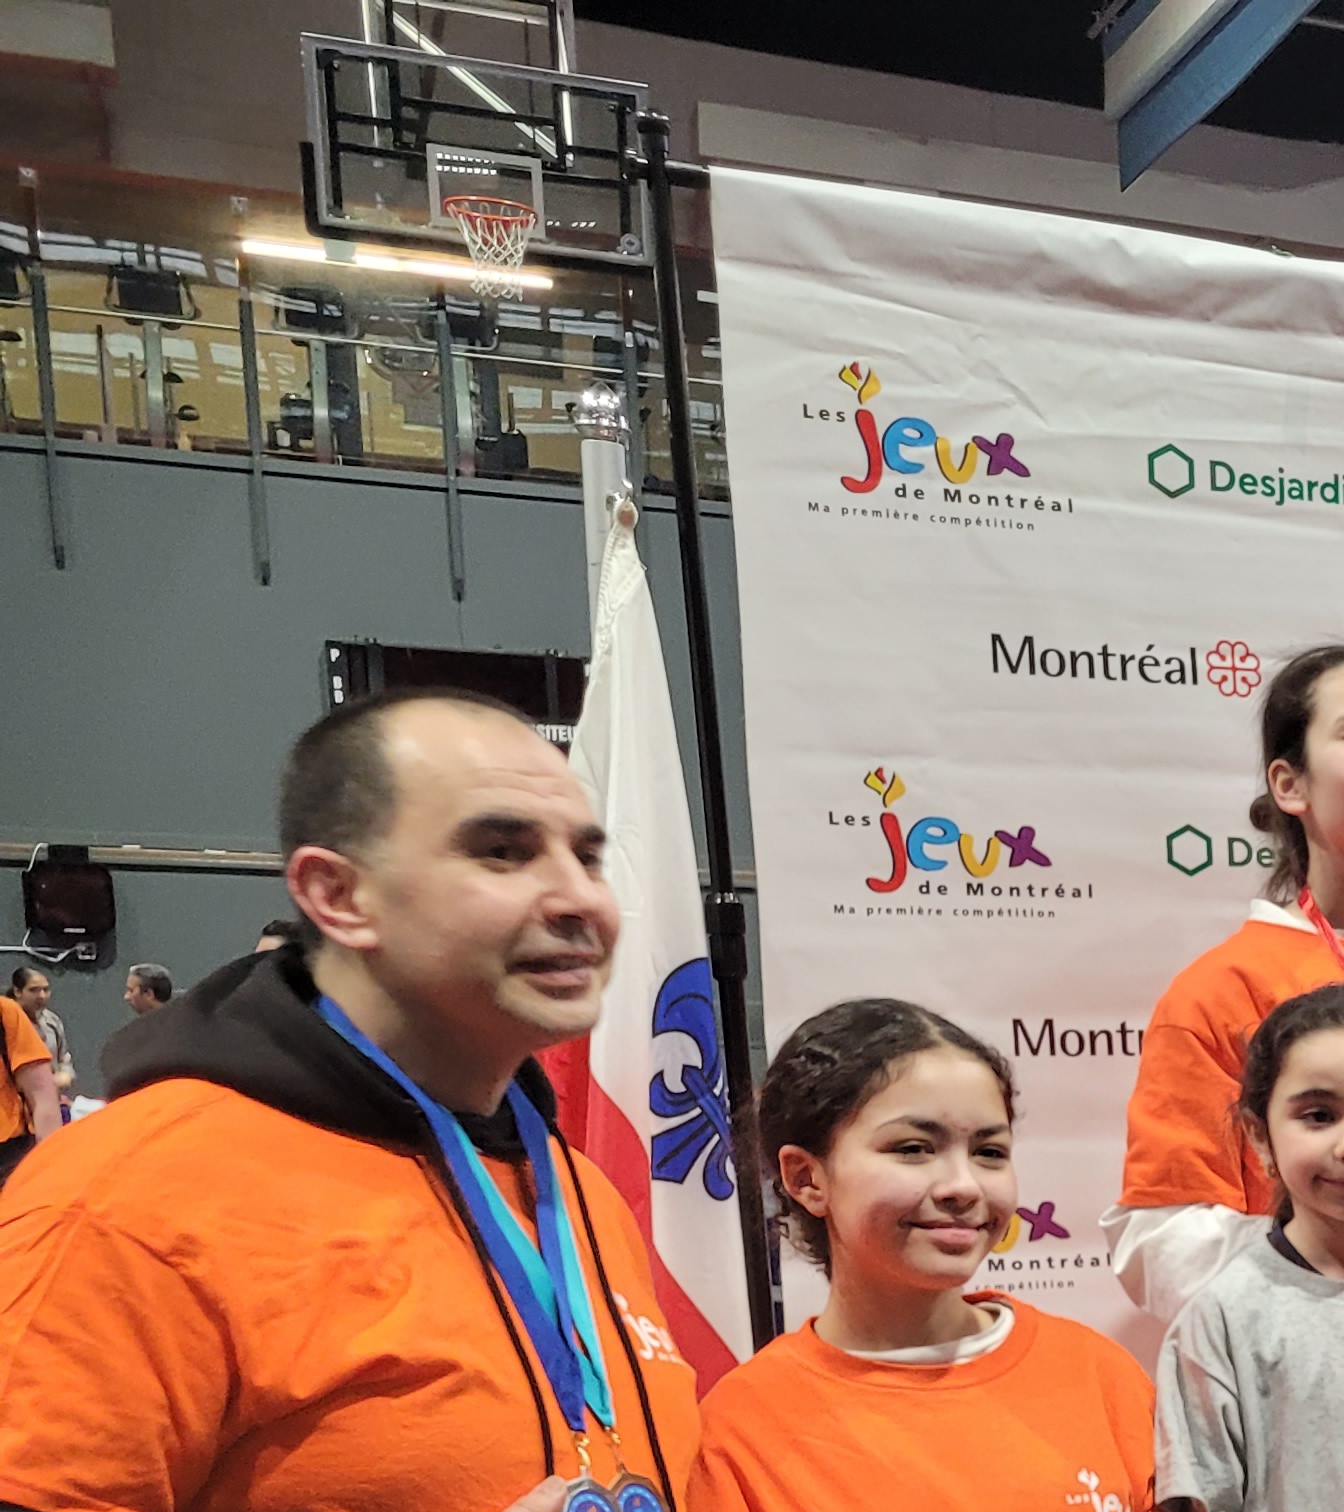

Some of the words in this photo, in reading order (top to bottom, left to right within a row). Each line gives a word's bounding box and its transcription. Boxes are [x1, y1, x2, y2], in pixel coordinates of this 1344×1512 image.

[802, 403, 847, 423] Les
[841, 409, 1031, 494] jeux
[894, 484, 926, 500] de
[943, 487, 1074, 513] Montréal
[808, 501, 830, 514] Ma
[841, 505, 920, 522] première
[930, 513, 1035, 531] compétition
[991, 633, 1198, 686] Montréal
[828, 811, 871, 827] Les
[865, 812, 1052, 893] jeux
[918, 880, 949, 896] de
[966, 882, 1093, 899] Montréal
[833, 904, 856, 915] Ma
[866, 904, 943, 918] première
[953, 907, 1056, 919] compétition
[988, 1253, 1111, 1272] Montréal
